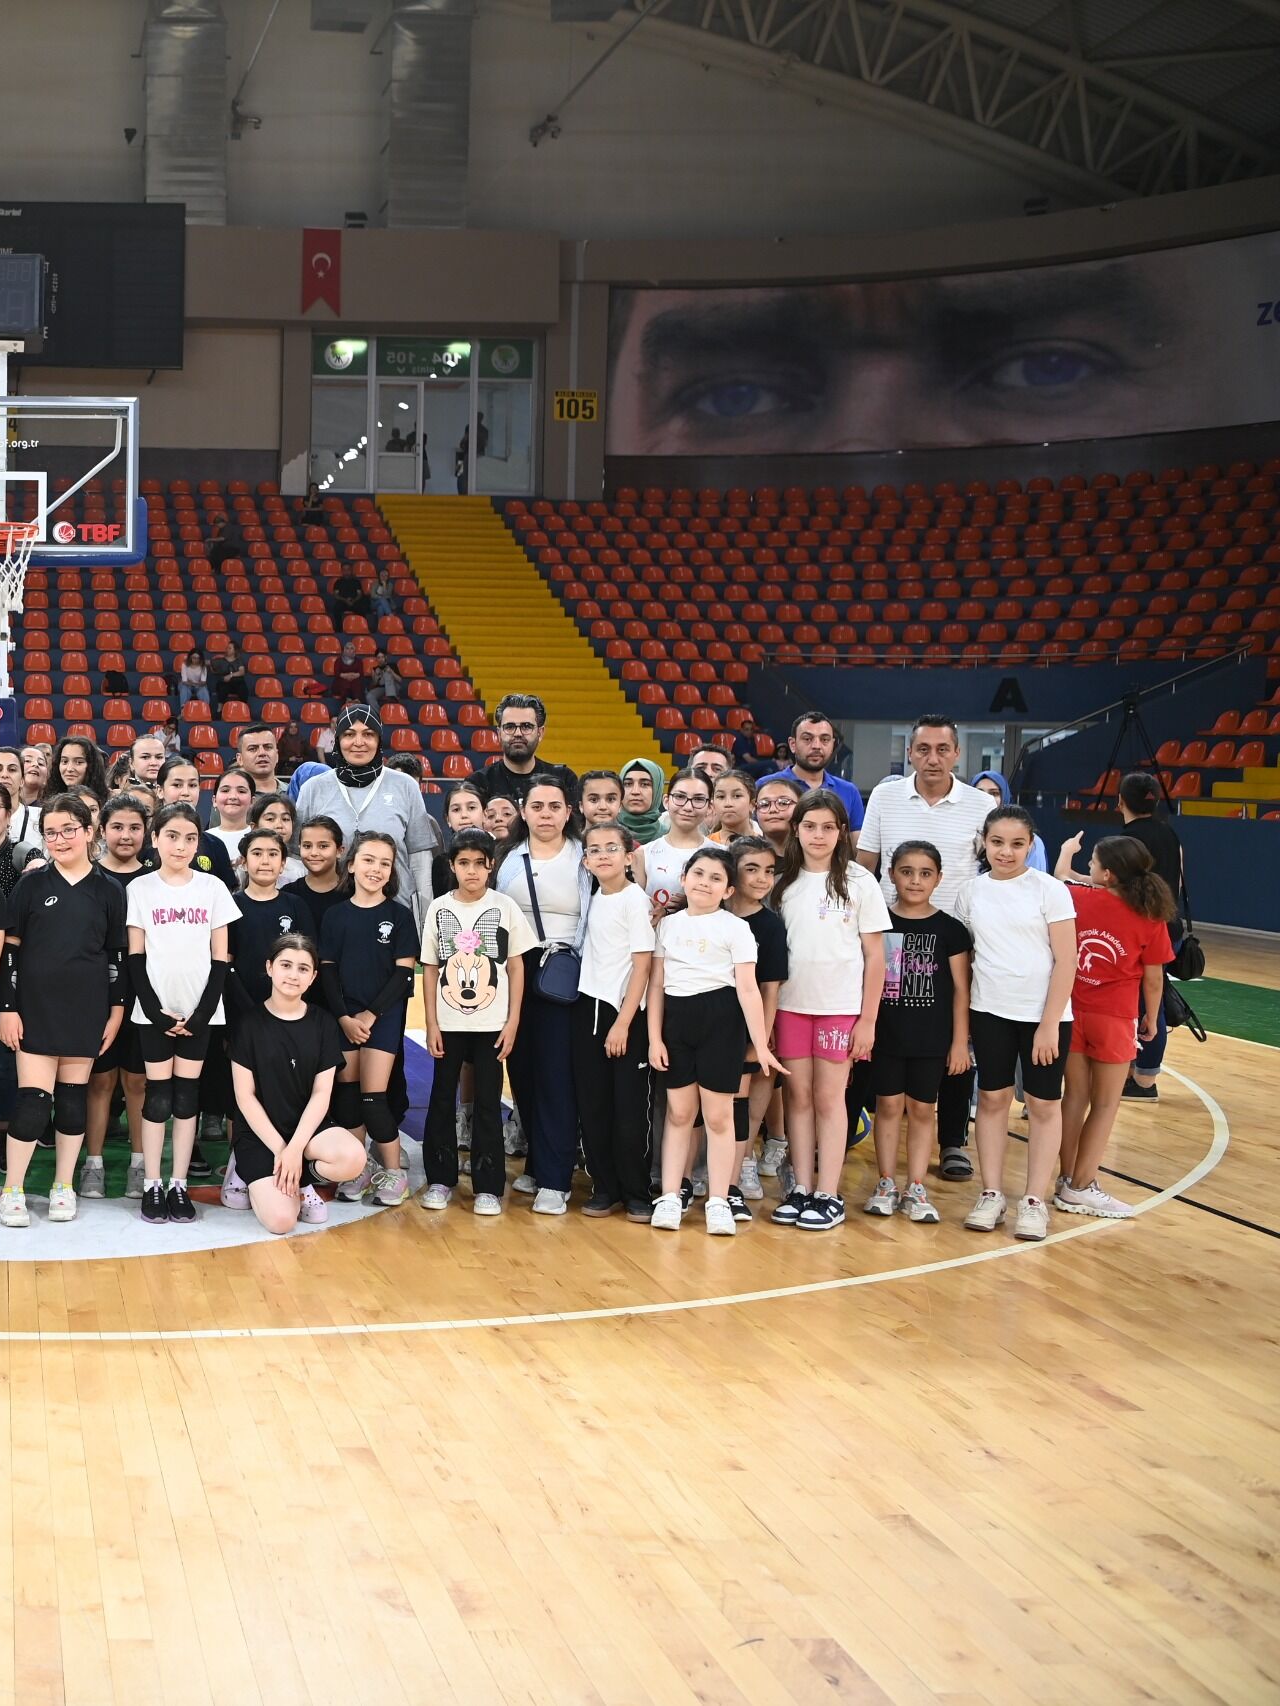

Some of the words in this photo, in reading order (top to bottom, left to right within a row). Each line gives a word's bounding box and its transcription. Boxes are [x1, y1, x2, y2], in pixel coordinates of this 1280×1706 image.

[556, 398, 595, 420] 105
[77, 523, 121, 542] TBF
[989, 677, 1029, 713] A
[152, 907, 177, 925] NEW
[903, 932, 937, 952] CALI
[902, 951, 934, 974] FOR
[900, 973, 935, 998] NIA
